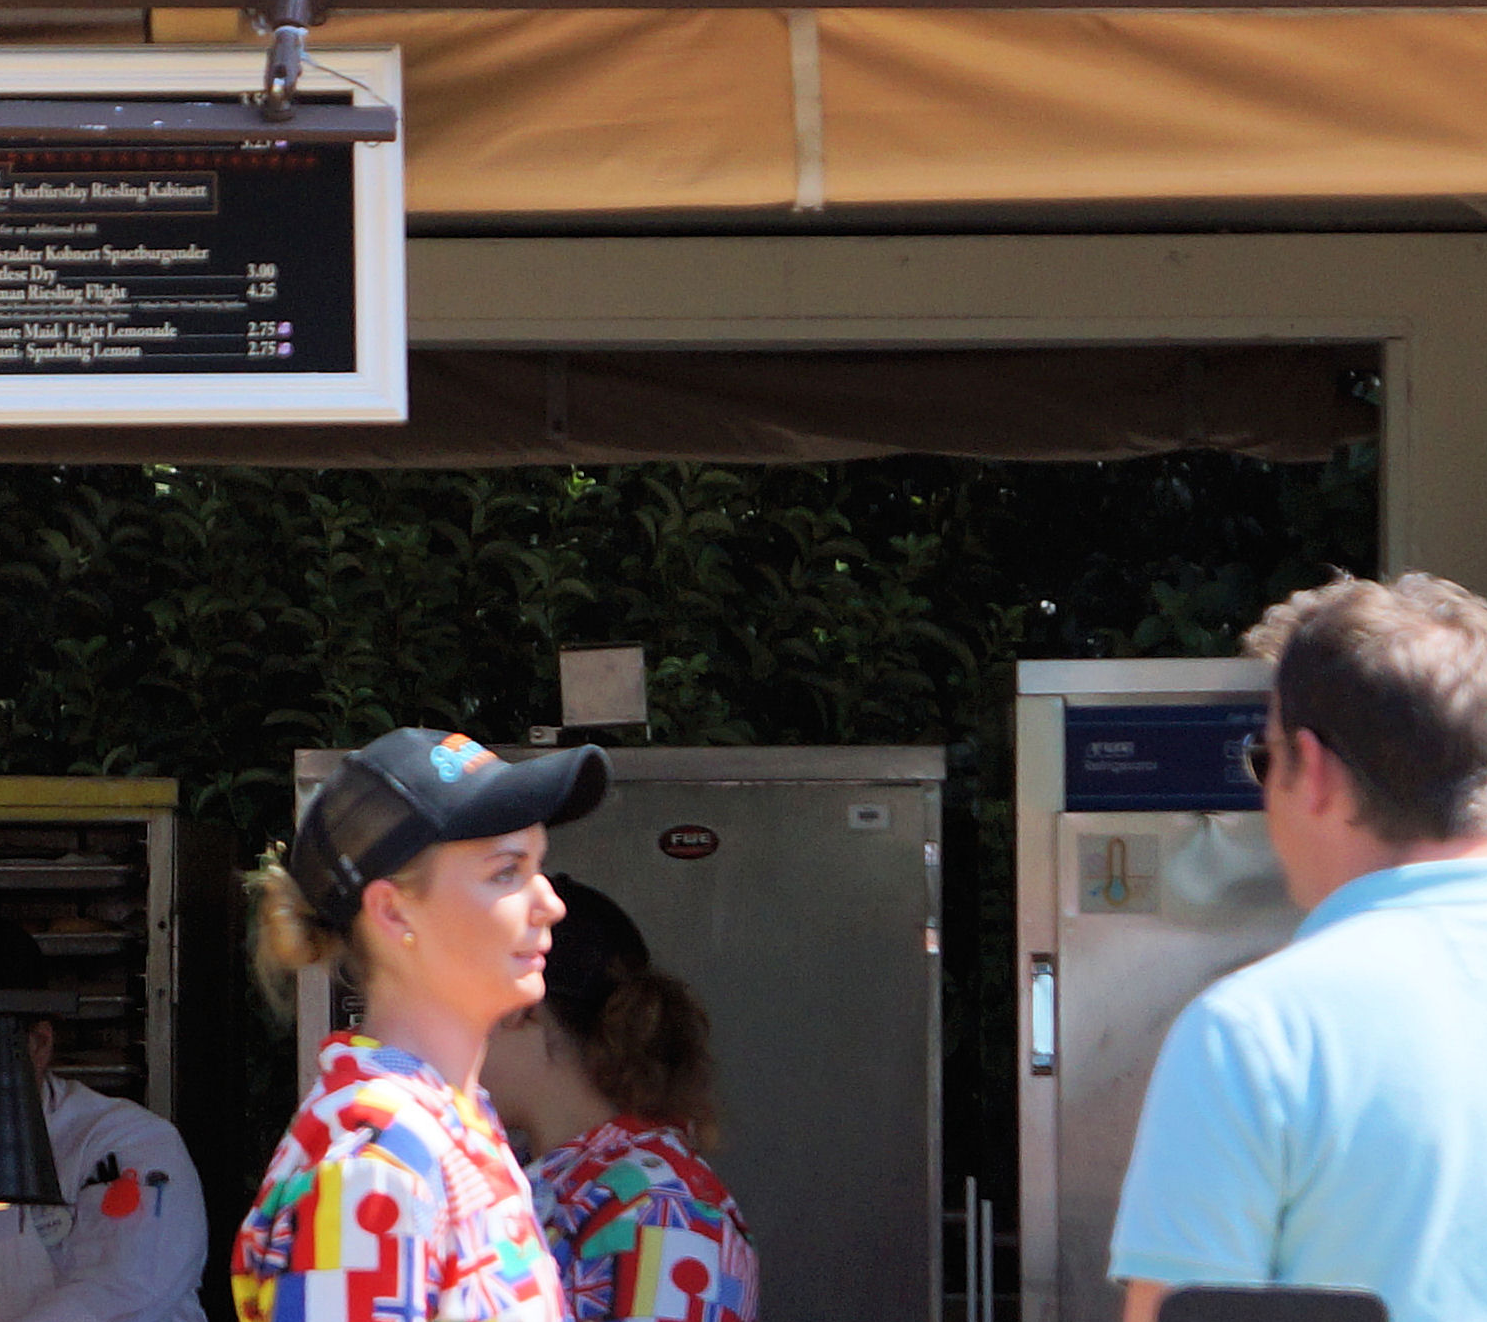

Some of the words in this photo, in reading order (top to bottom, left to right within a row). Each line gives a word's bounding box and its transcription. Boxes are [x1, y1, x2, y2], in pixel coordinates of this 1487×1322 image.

[91, 182, 147, 204] Riesling
[149, 181, 208, 199] Kabinett
[29, 266, 57, 286] Dry
[246, 263, 276, 278] 3.00
[27, 285, 83, 305] Riesling
[85, 284, 127, 304] Flight
[246, 283, 276, 298] 4.25
[66, 322, 104, 343] Light
[106, 322, 177, 338] Lemonade
[247, 321, 276, 336] 2.75
[26, 343, 91, 364] Sparkling
[93, 344, 142, 358] Lemon
[247, 341, 276, 356] 2.75
